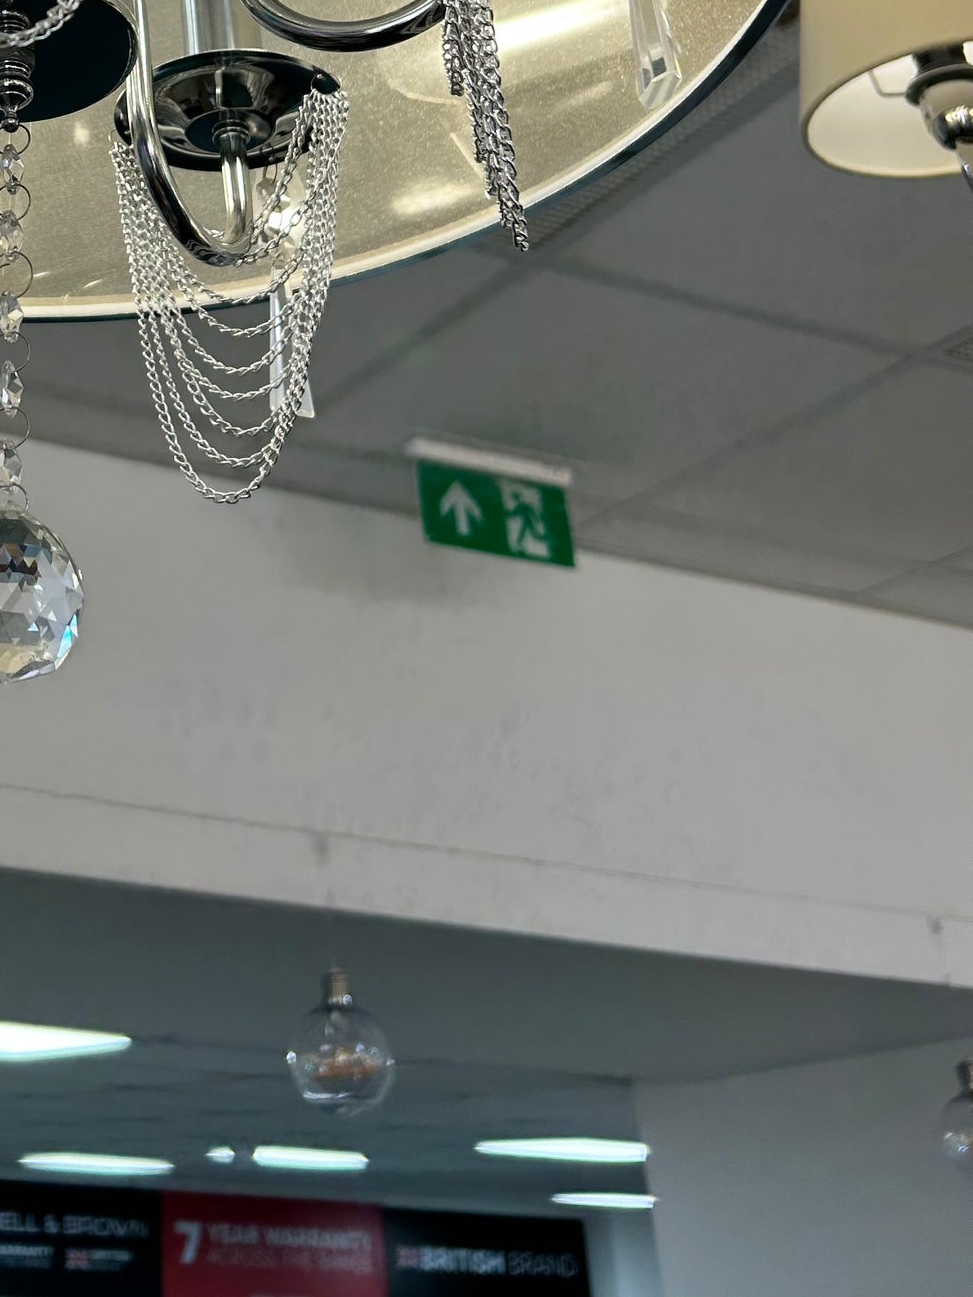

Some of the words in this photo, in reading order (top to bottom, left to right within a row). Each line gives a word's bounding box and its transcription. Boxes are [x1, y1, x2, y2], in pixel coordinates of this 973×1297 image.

[44, 1213, 61, 1234] &
[63, 1215, 149, 1238] BROWN
[172, 1220, 203, 1265] 7
[206, 1223, 260, 1244] YEAR
[263, 1225, 373, 1250] WARRANTY
[419, 1245, 506, 1275] BRITISH
[508, 1250, 580, 1278] BRAND
